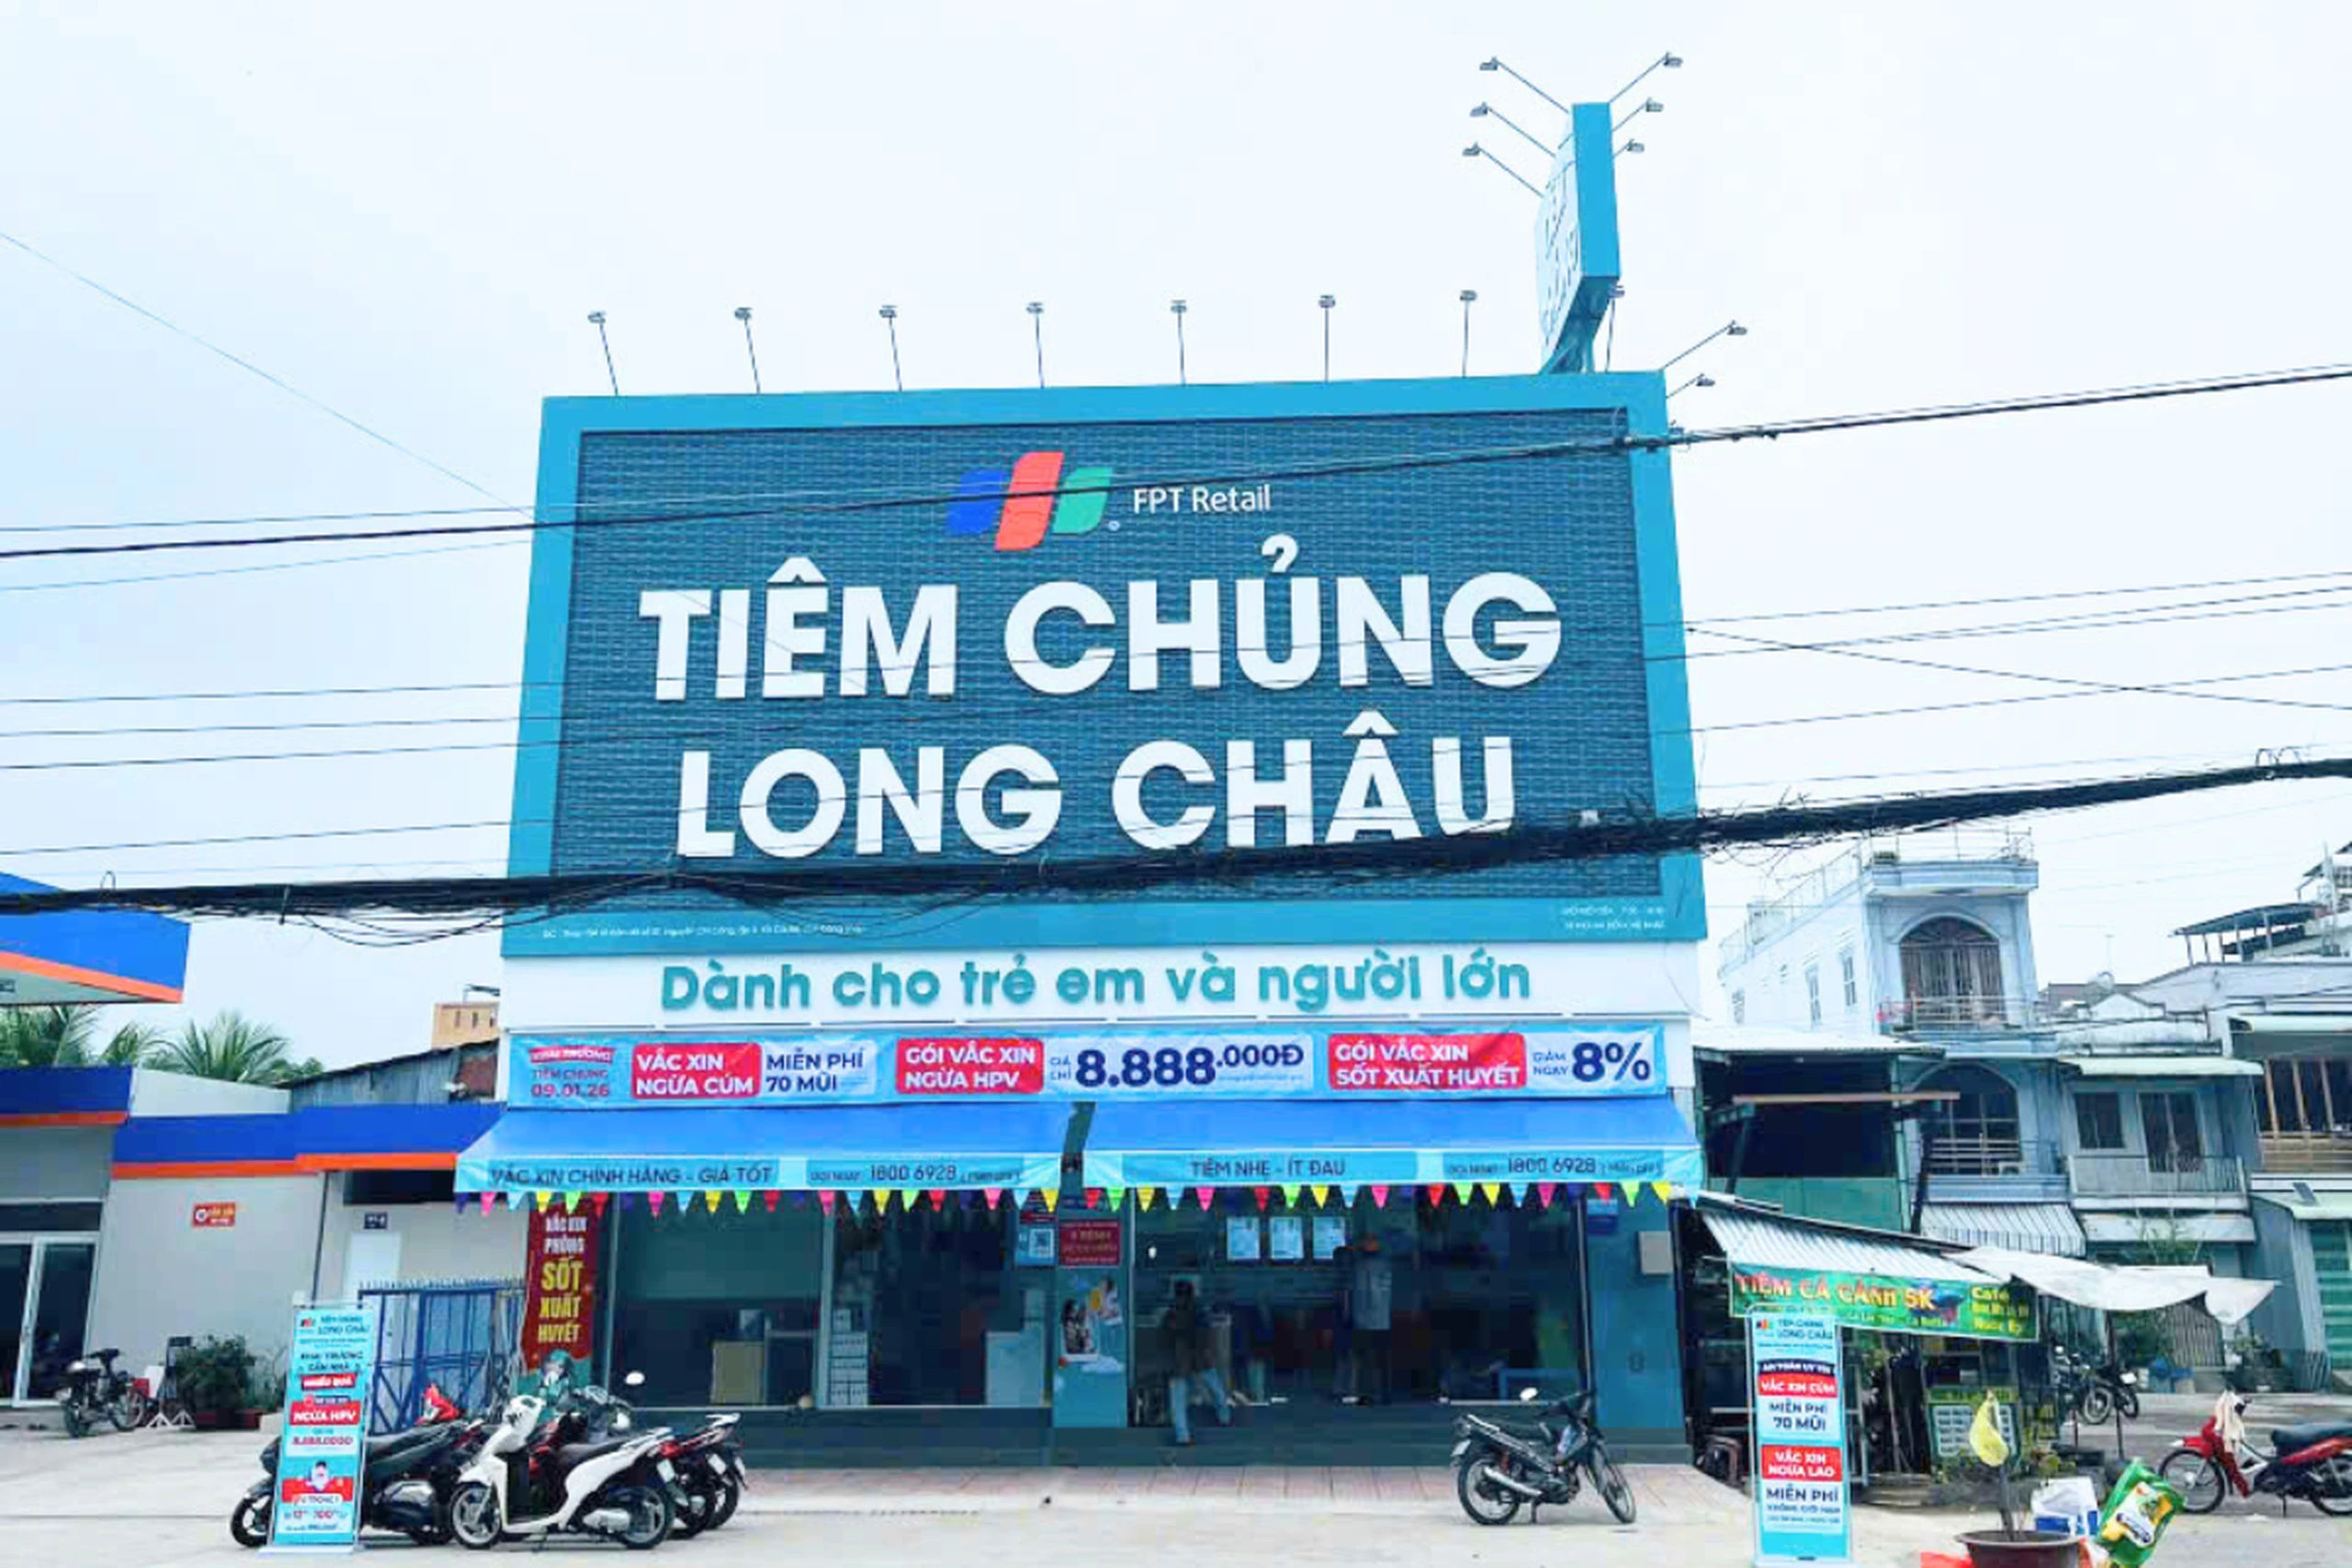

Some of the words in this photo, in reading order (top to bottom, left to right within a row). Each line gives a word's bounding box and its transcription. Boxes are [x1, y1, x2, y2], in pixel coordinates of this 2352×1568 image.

[1133, 487, 1184, 514] FPT
[1193, 483, 1272, 513] Retail
[639, 557, 957, 701] TIÊM
[1004, 534, 1561, 695] CHỦNG
[677, 744, 1062, 858] LONG
[1112, 709, 1515, 851] CHÂU
[662, 958, 810, 1010] Dành
[832, 962, 941, 1008] cho
[960, 953, 1036, 1006] trẻ
[1056, 965, 1145, 1004] em
[1166, 951, 1236, 1002] và
[1258, 947, 1422, 1013] người
[1442, 947, 1530, 999] lớn
[637, 1048, 684, 1072] VẮC
[687, 1053, 724, 1071] XIN
[766, 1047, 821, 1070] MIỄN
[828, 1047, 864, 1069] PHÍ
[905, 1043, 947, 1065] GÓI
[949, 1043, 994, 1065] VẮC
[1000, 1047, 1036, 1064] XIN
[1336, 1043, 1375, 1062] GÓI
[1379, 1043, 1427, 1062] VẮC
[1430, 1043, 1469, 1062] XIN
[1572, 1042, 1650, 1083] 8%
[703, 1073, 754, 1094] CÚM
[766, 1076, 790, 1092] 70
[796, 1072, 837, 1092] MŨI
[973, 1071, 1021, 1088] HPV
[1336, 1064, 1377, 1086] SỐT
[1385, 1063, 1442, 1085] XUẤT
[1448, 1064, 1520, 1086] HUYẾT
[871, 1164, 910, 1181] 1800
[913, 1164, 956, 1181] 6928
[1192, 1156, 1230, 1178] TIÊM
[1508, 1156, 1548, 1174] 1800
[1554, 1156, 1596, 1174] 6928
[541, 1256, 584, 1291] SỐT
